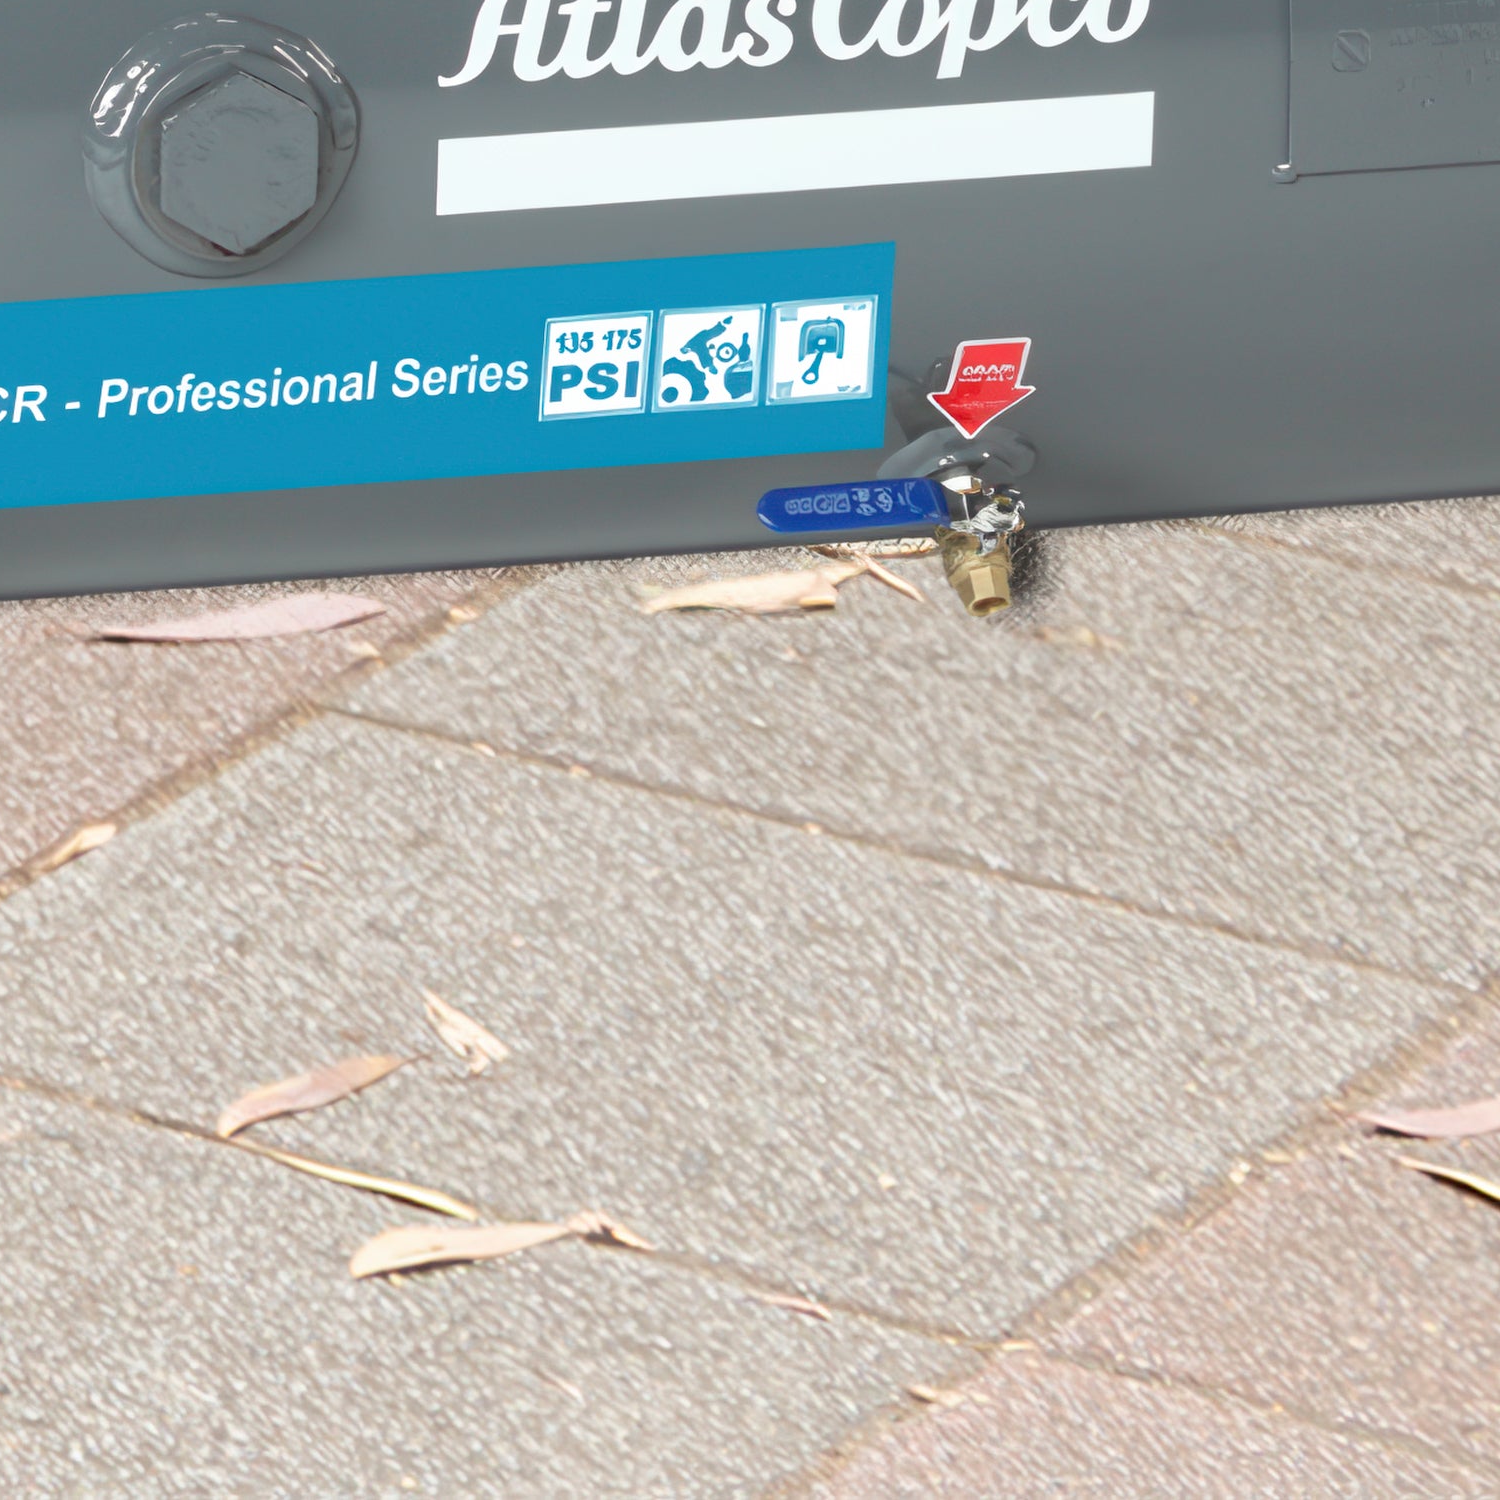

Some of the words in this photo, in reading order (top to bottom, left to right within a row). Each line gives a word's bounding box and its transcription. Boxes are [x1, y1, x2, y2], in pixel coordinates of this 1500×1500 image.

[97, 360, 378, 419] Professional
[390, 354, 530, 399] Series
[549, 360, 640, 404] PSI
